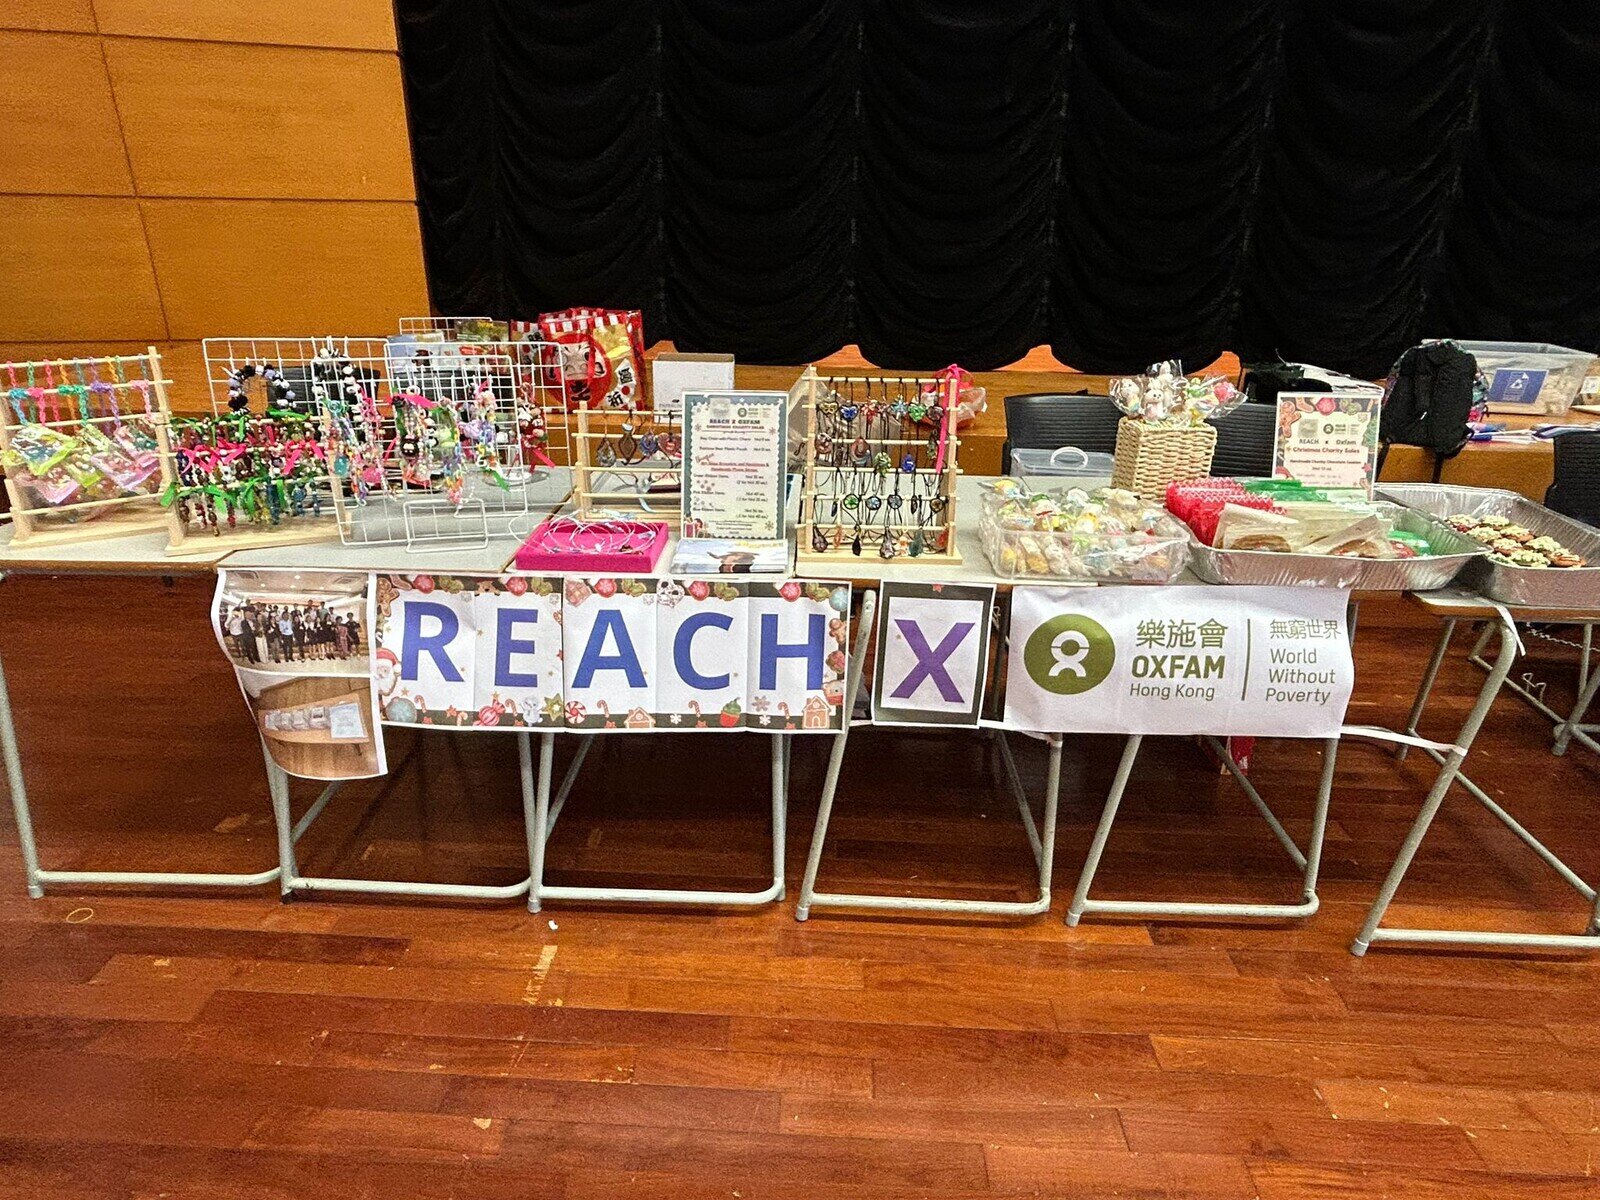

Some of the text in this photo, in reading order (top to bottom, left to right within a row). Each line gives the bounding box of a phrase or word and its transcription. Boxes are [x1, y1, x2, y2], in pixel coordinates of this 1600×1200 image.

[1136, 618, 1228, 649] 樂施會
[1270, 619, 1341, 640] 無窮世界
[400, 601, 826, 692] REACH
[1270, 648, 1318, 664] World
[889, 619, 975, 703] X
[1131, 655, 1226, 679] OXFAM
[1268, 668, 1336, 684] Without
[1129, 683, 1215, 701] Hong Kong
[1265, 687, 1331, 705] Poverty
